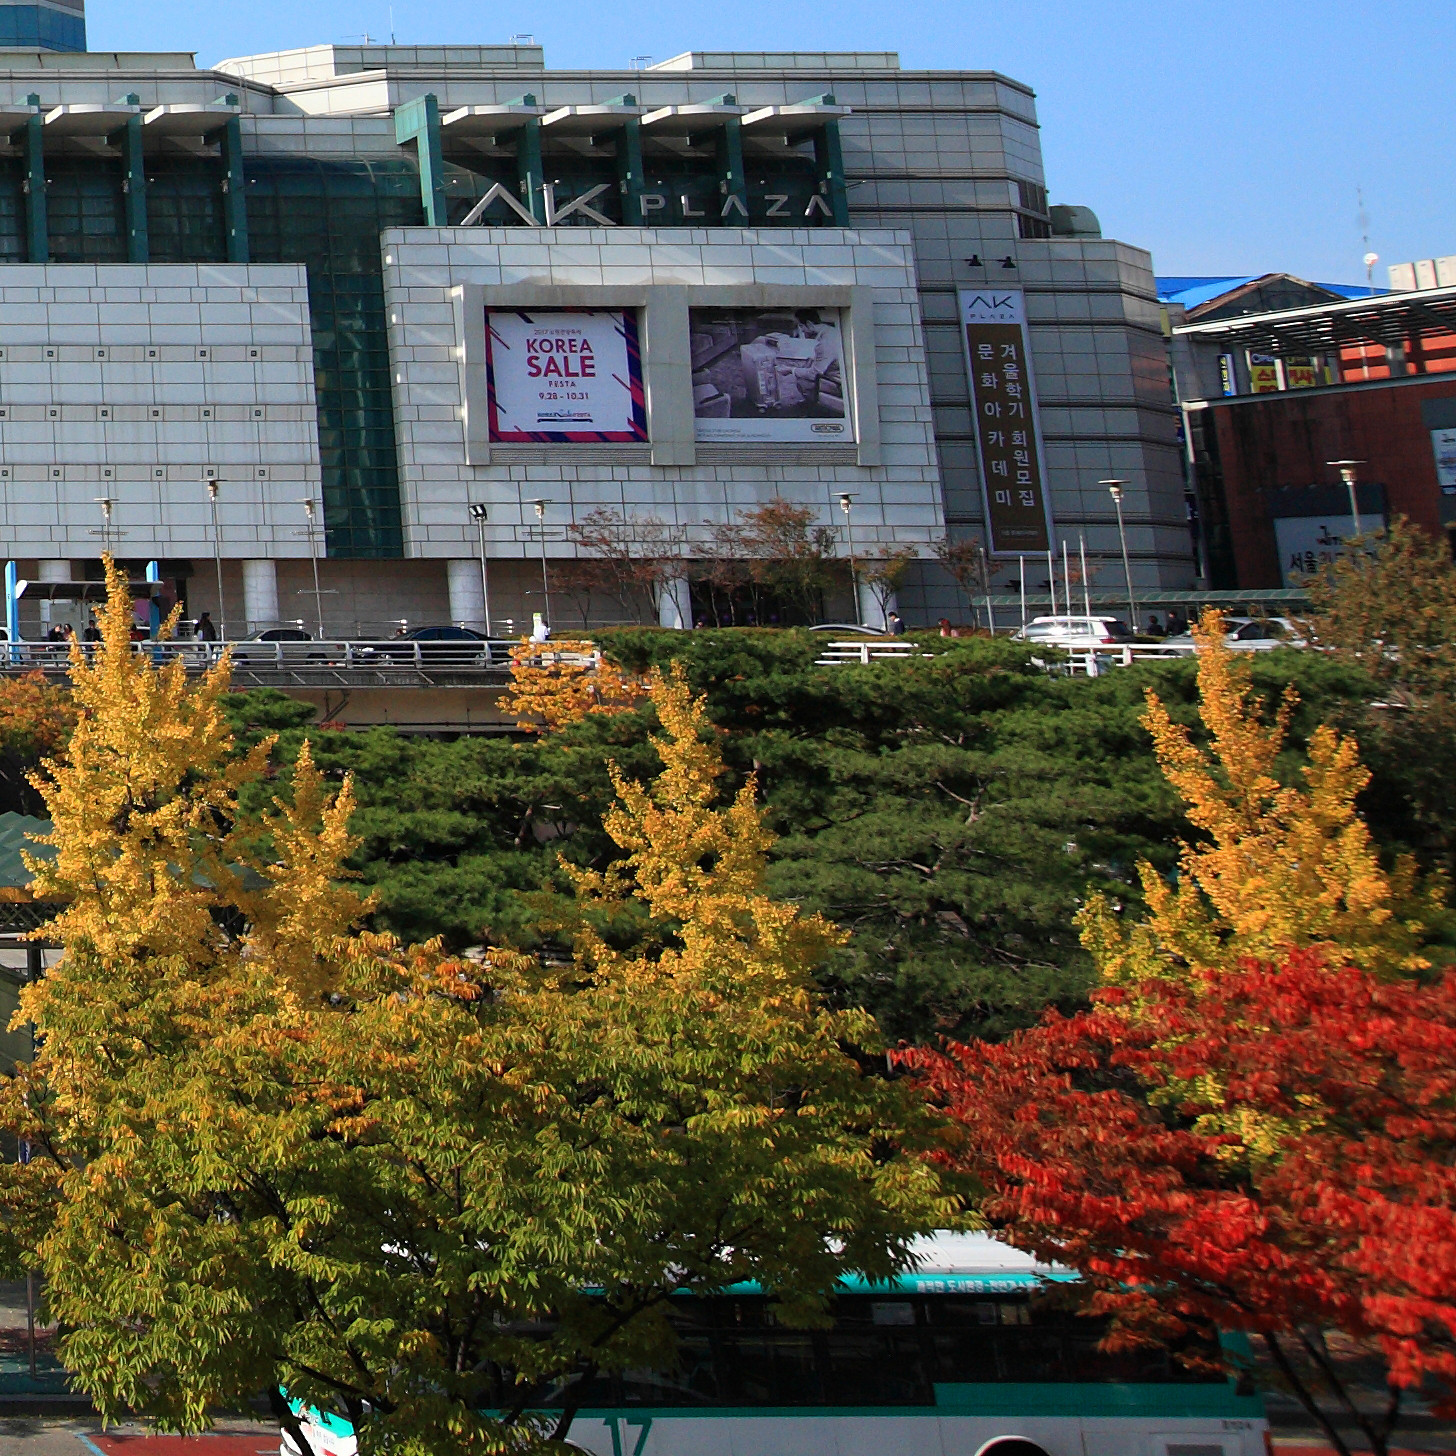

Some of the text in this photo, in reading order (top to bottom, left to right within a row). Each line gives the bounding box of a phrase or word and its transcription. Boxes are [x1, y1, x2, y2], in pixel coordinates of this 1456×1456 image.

[460, 182, 834, 227] AK PLAZA
[969, 296, 1014, 309] AK
[526, 338, 593, 353] KOREA
[526, 355, 596, 378] SALE
[999, 344, 1025, 419] 겨울학기
[976, 343, 1013, 507] 문화아카데미
[1010, 430, 1036, 508] 회원모집
